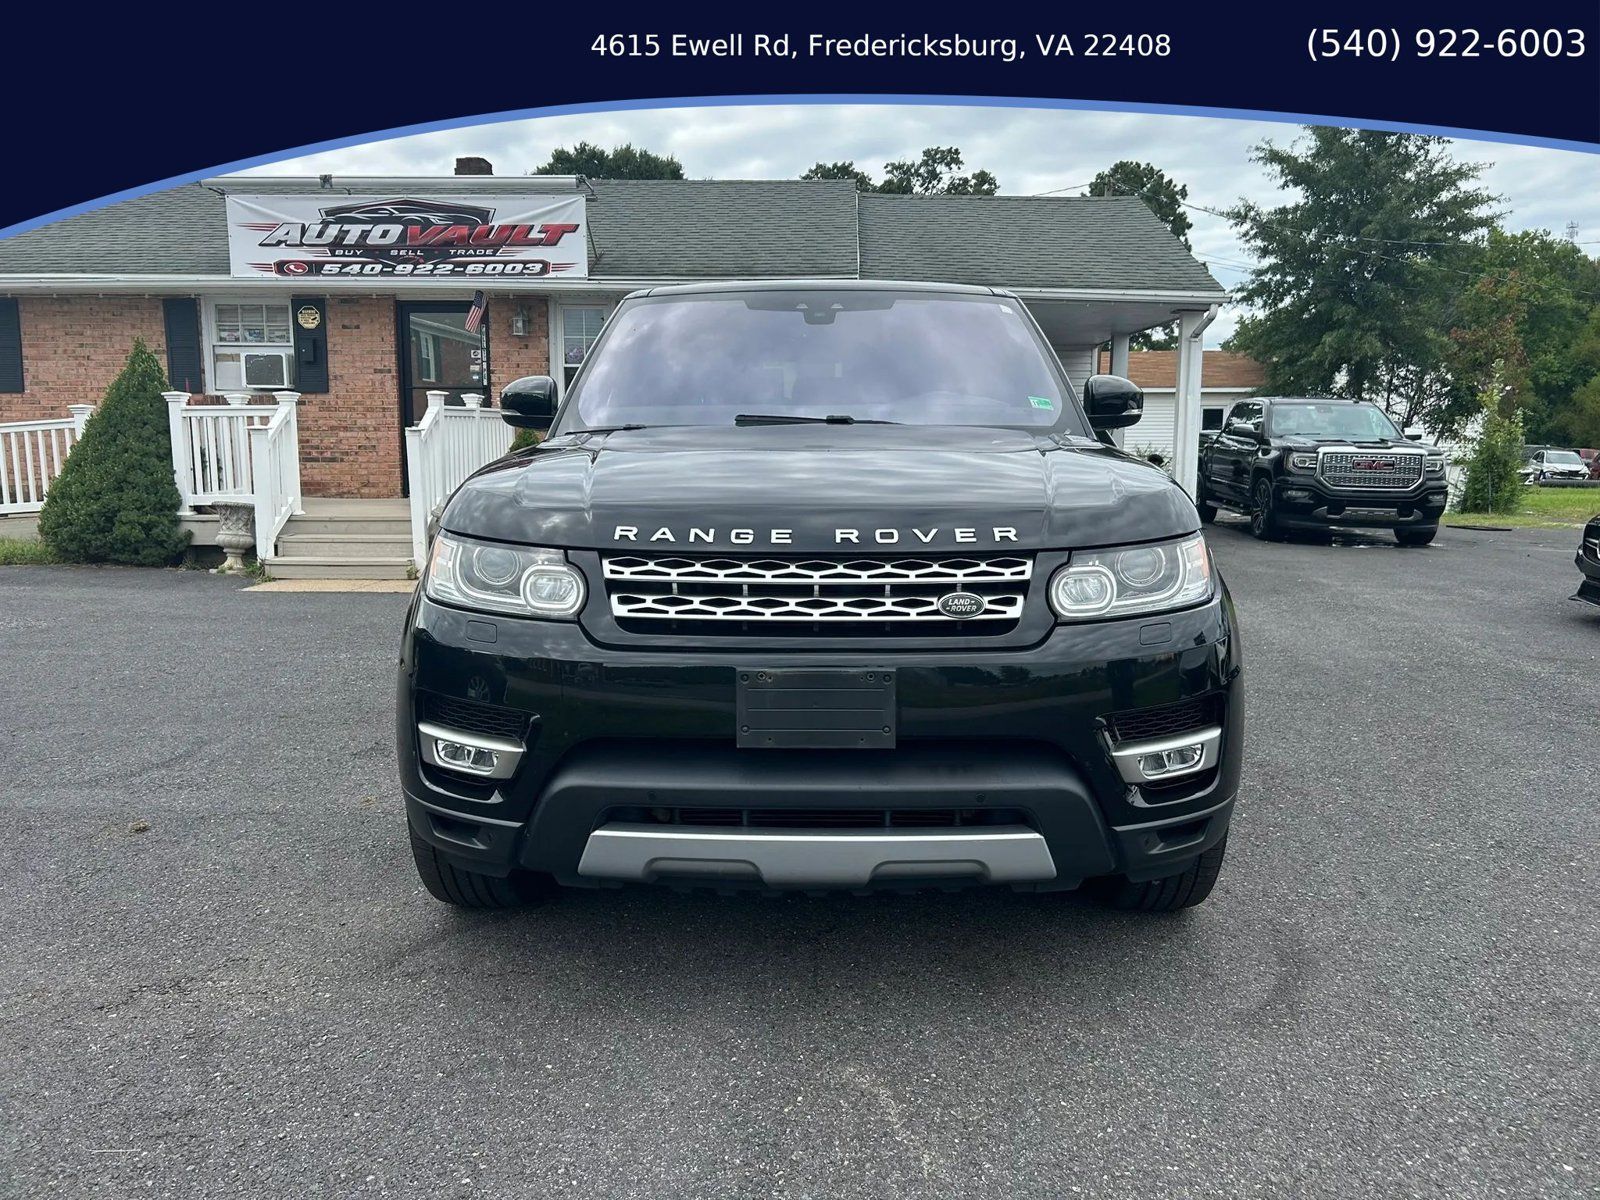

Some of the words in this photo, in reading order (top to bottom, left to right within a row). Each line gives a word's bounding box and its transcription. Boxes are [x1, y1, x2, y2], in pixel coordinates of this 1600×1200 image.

[320, 263, 544, 276] 540-922-6003
[1353, 460, 1394, 470] GMC
[613, 525, 793, 545] RANGE
[834, 526, 1019, 544] ROVER
